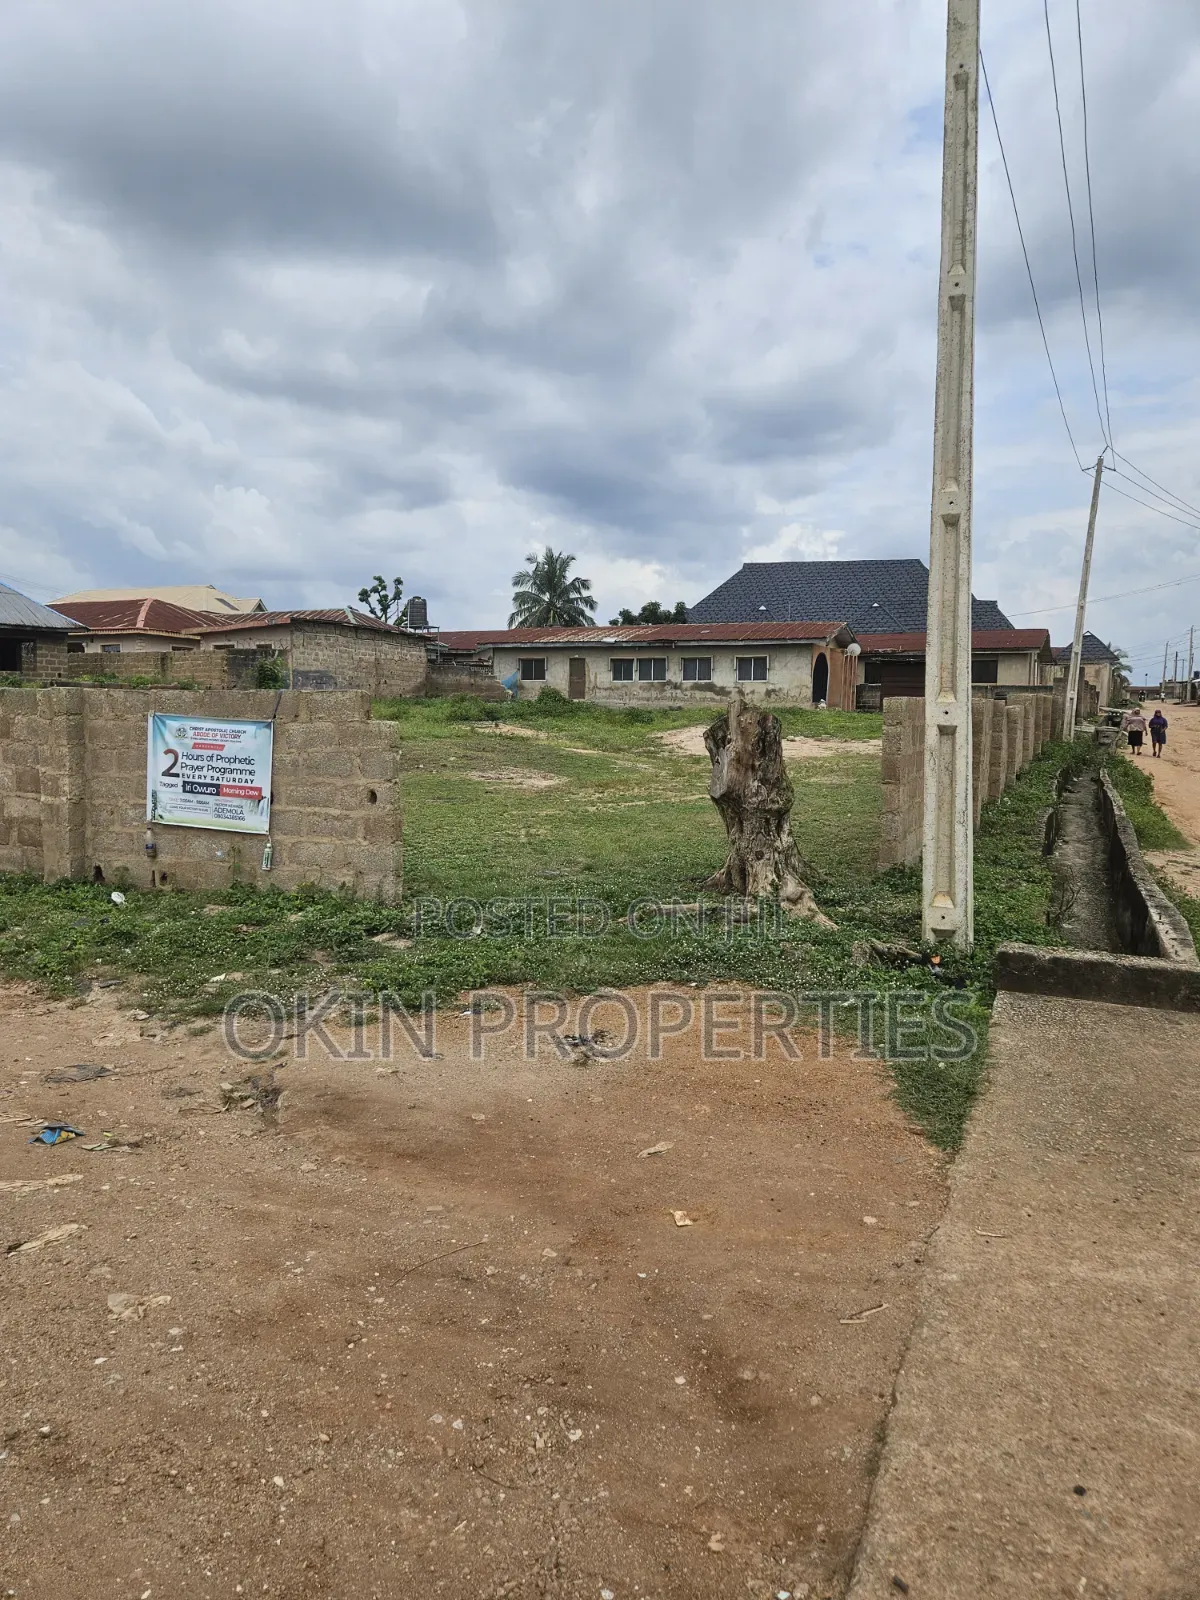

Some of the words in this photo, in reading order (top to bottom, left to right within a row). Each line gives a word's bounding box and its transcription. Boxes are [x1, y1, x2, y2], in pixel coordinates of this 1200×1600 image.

[161, 748, 180, 777] 2
[181, 752, 204, 761] Hours
[206, 754, 215, 762] of
[215, 754, 255, 766] Prophetic
[180, 762, 206, 774] Prayer
[206, 763, 256, 776] Programme
[210, 776, 255, 784] SATURDAY
[192, 784, 217, 794] Owuro
[223, 787, 245, 796] Morning
[213, 806, 244, 816] ADEMOLA
